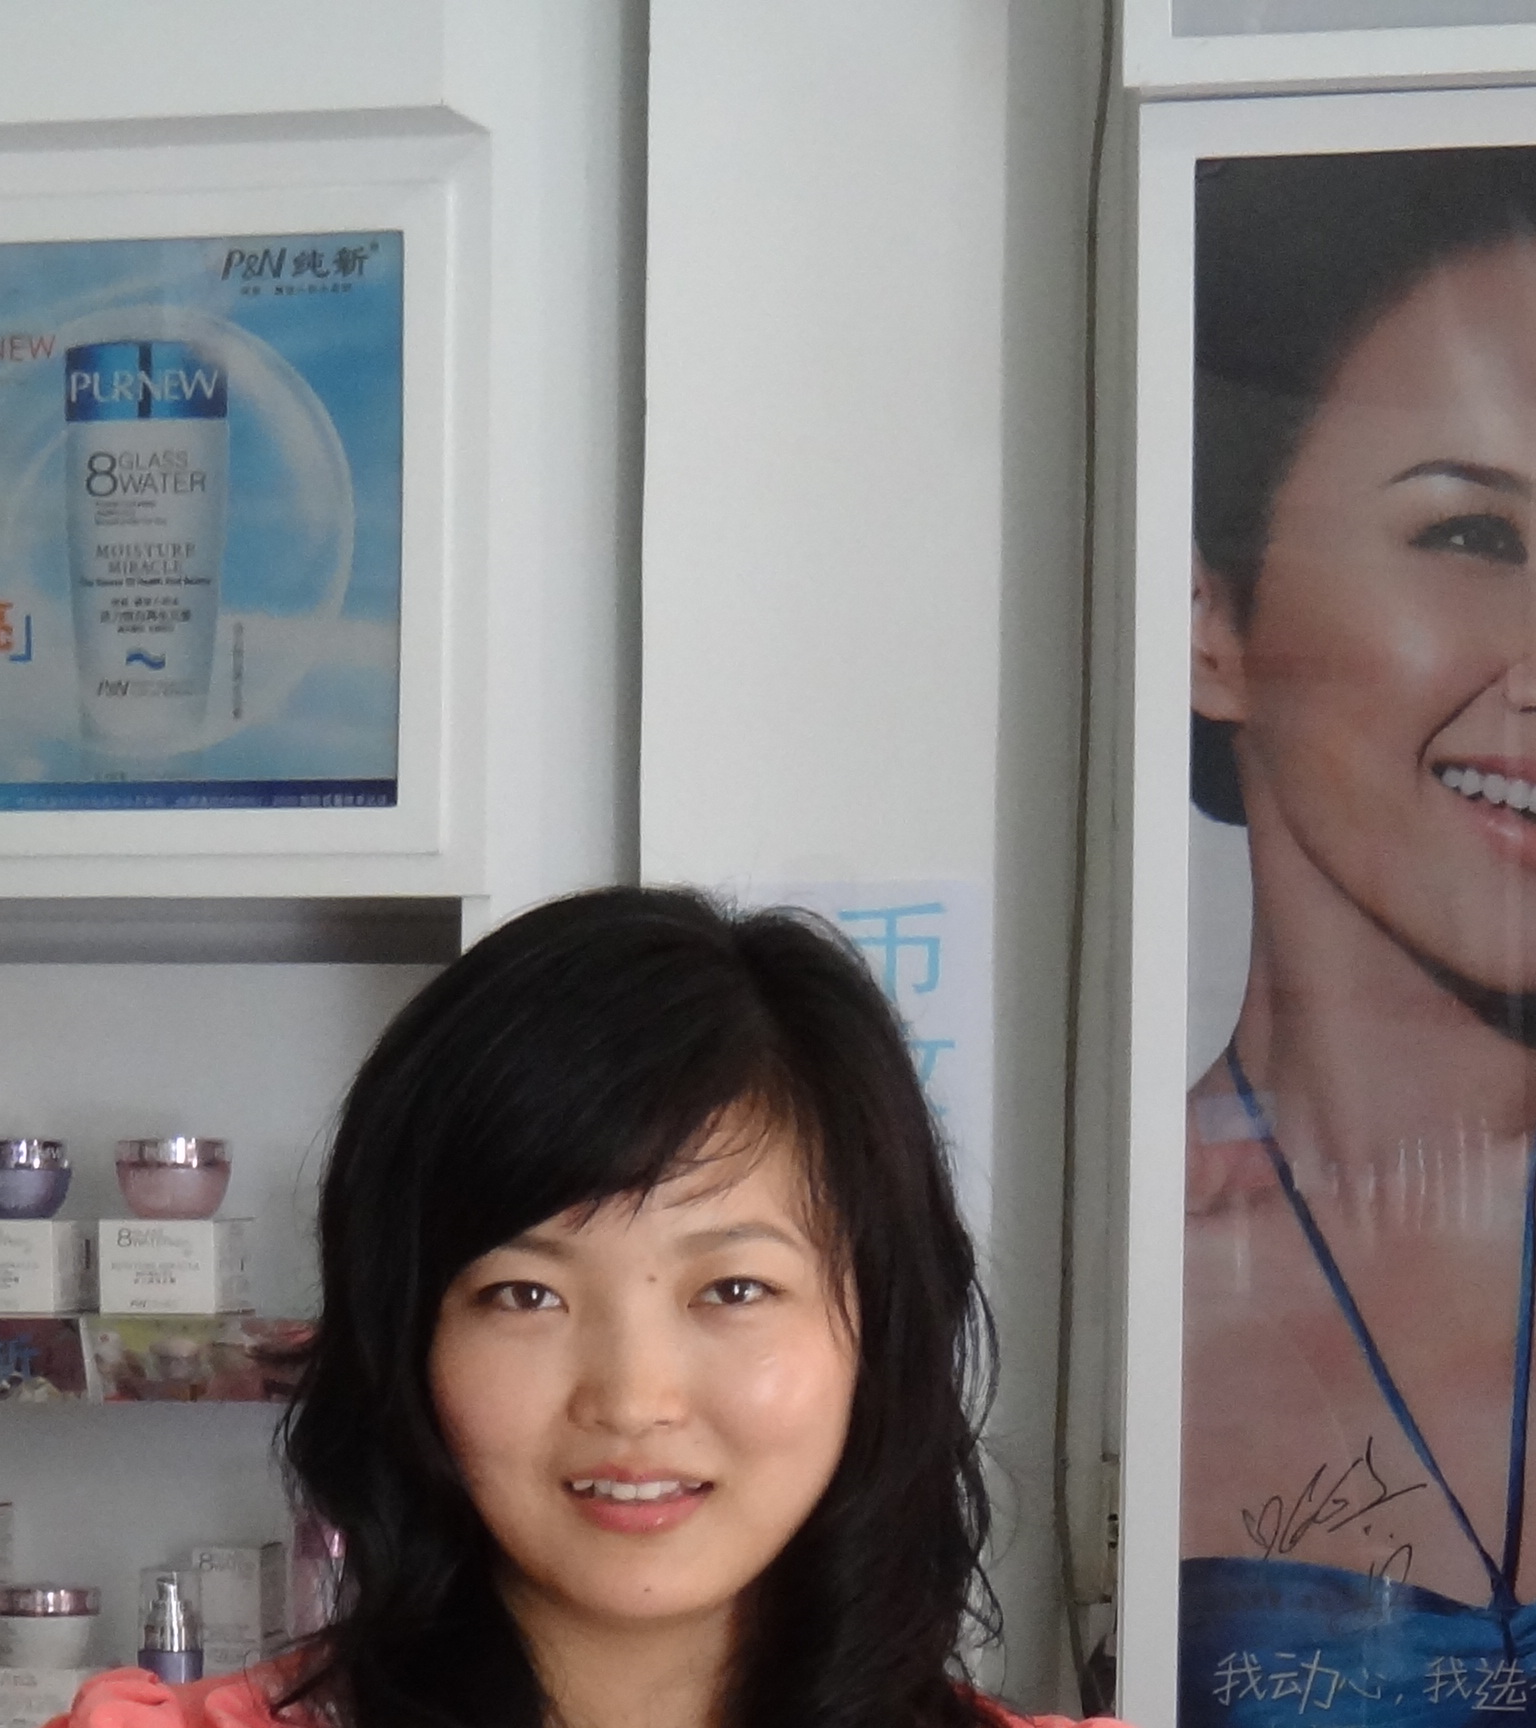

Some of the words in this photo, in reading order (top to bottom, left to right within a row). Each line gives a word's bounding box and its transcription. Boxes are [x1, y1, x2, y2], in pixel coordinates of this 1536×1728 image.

[222, 248, 286, 280] P&N
[70, 369, 219, 403] PURNEW
[85, 451, 118, 498] 8
[119, 473, 207, 494] WATER
